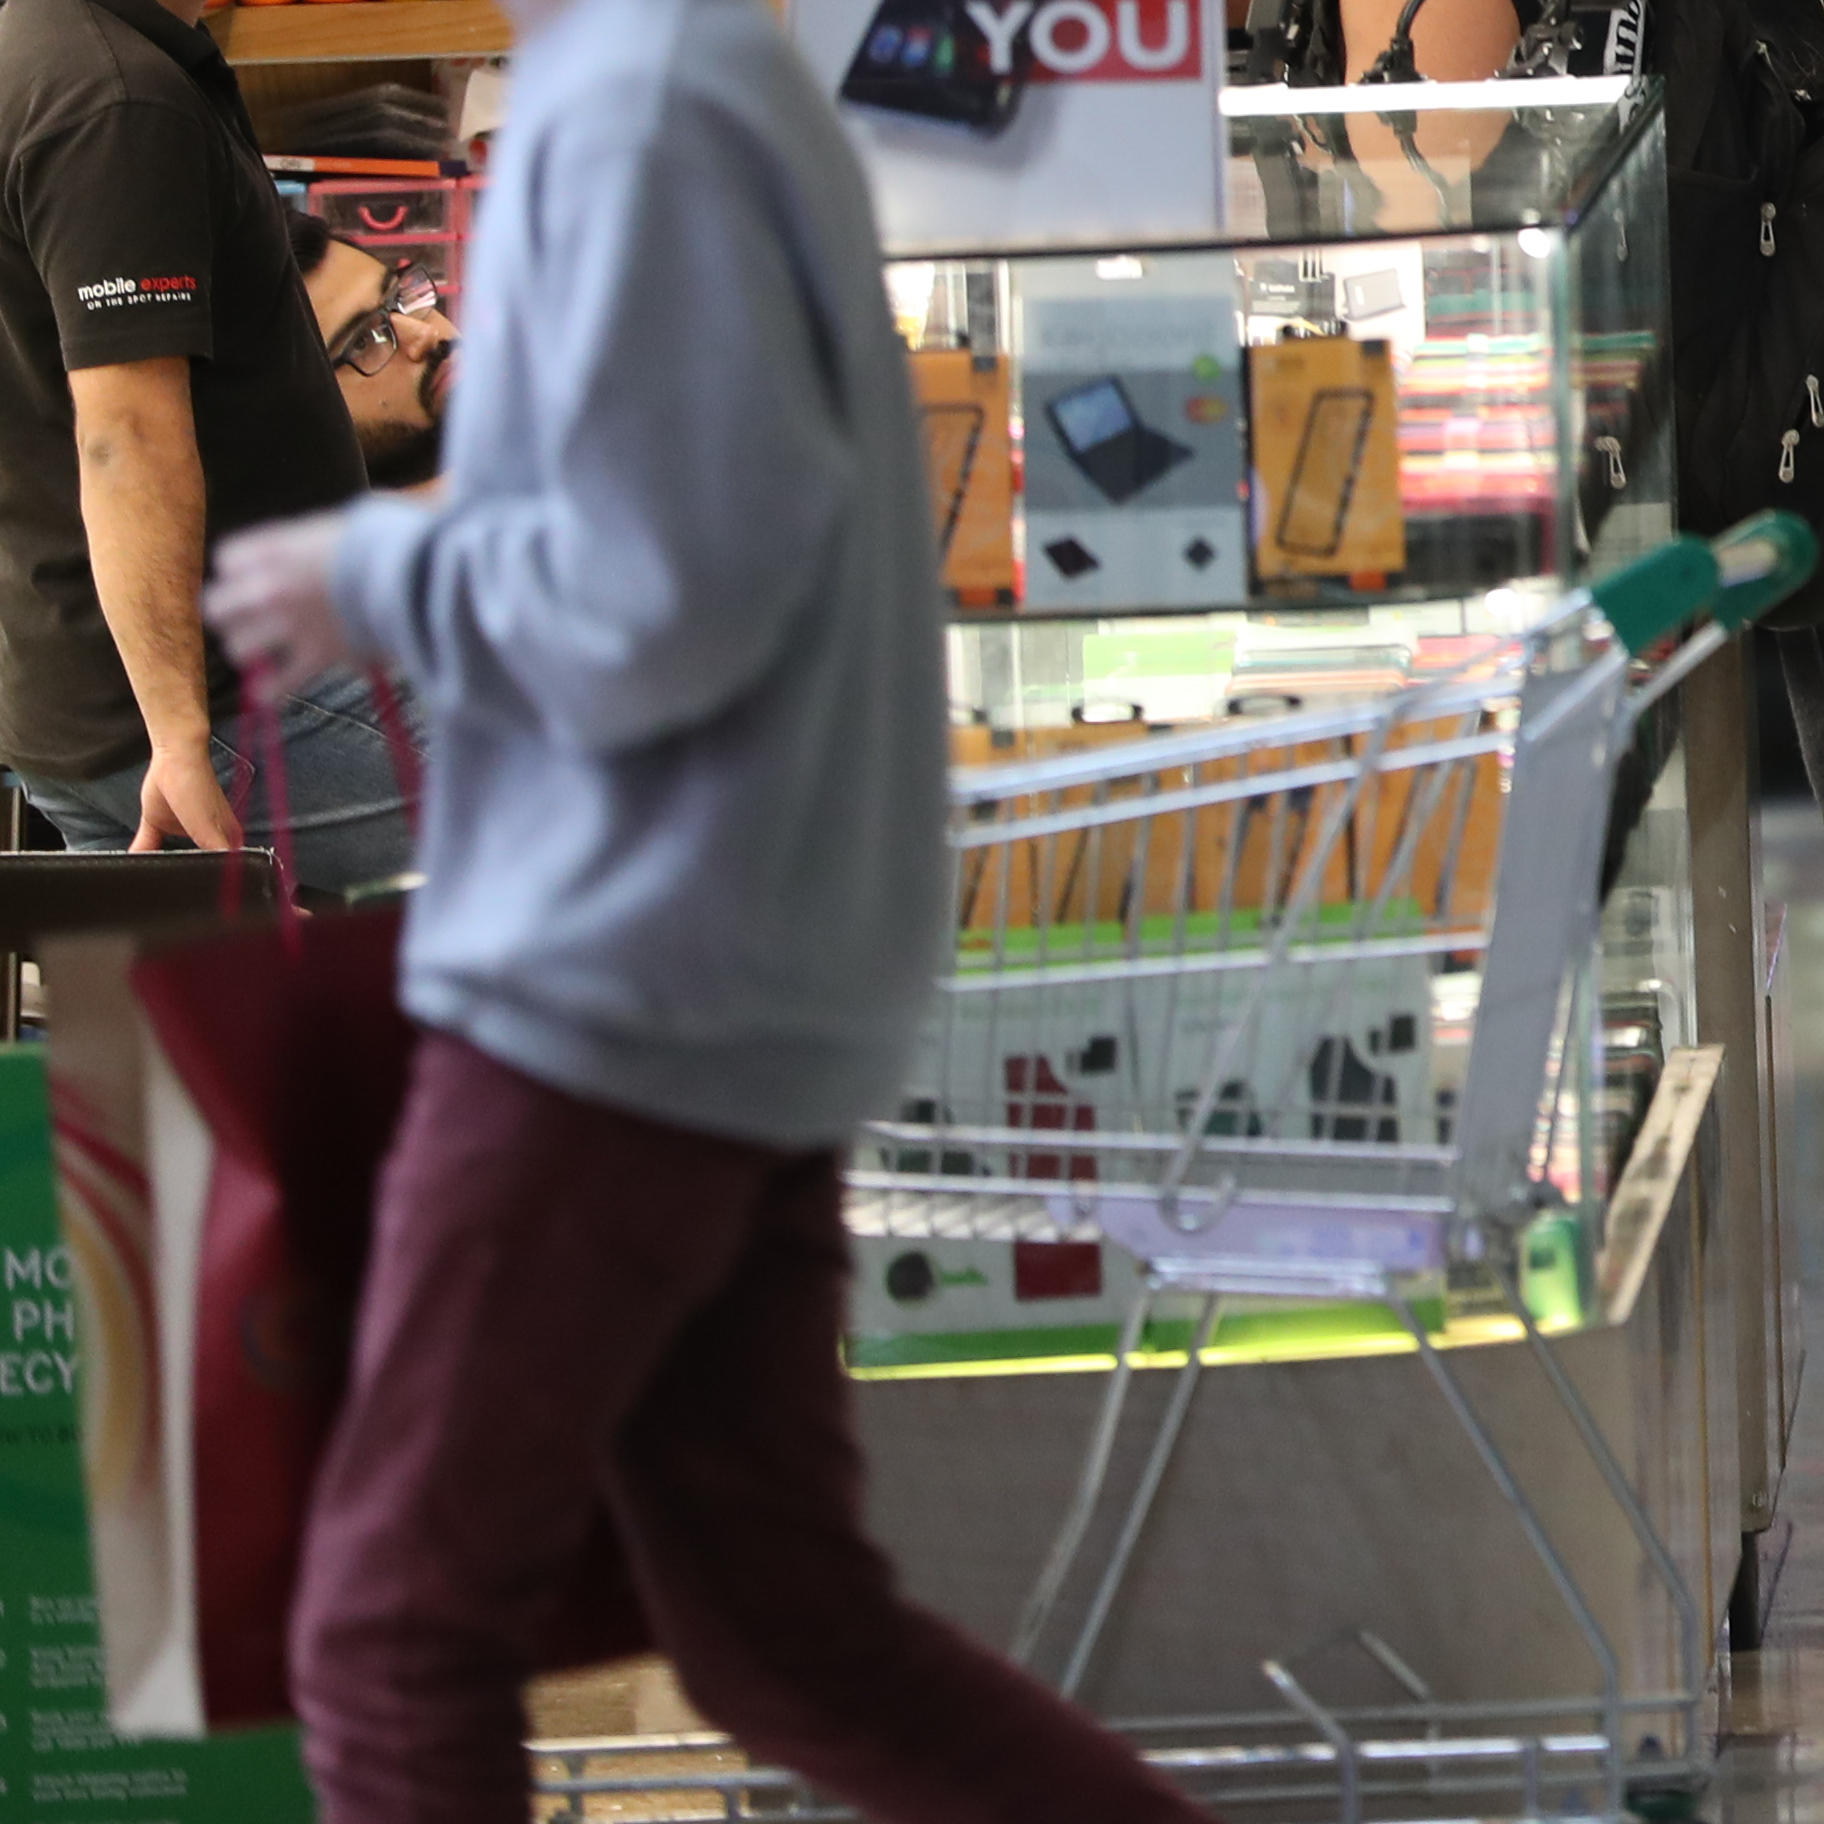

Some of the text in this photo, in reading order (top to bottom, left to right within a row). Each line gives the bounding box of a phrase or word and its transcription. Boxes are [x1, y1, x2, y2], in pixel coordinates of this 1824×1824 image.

[77, 275, 197, 301] mobile experts
[87, 300, 102, 311] ON
